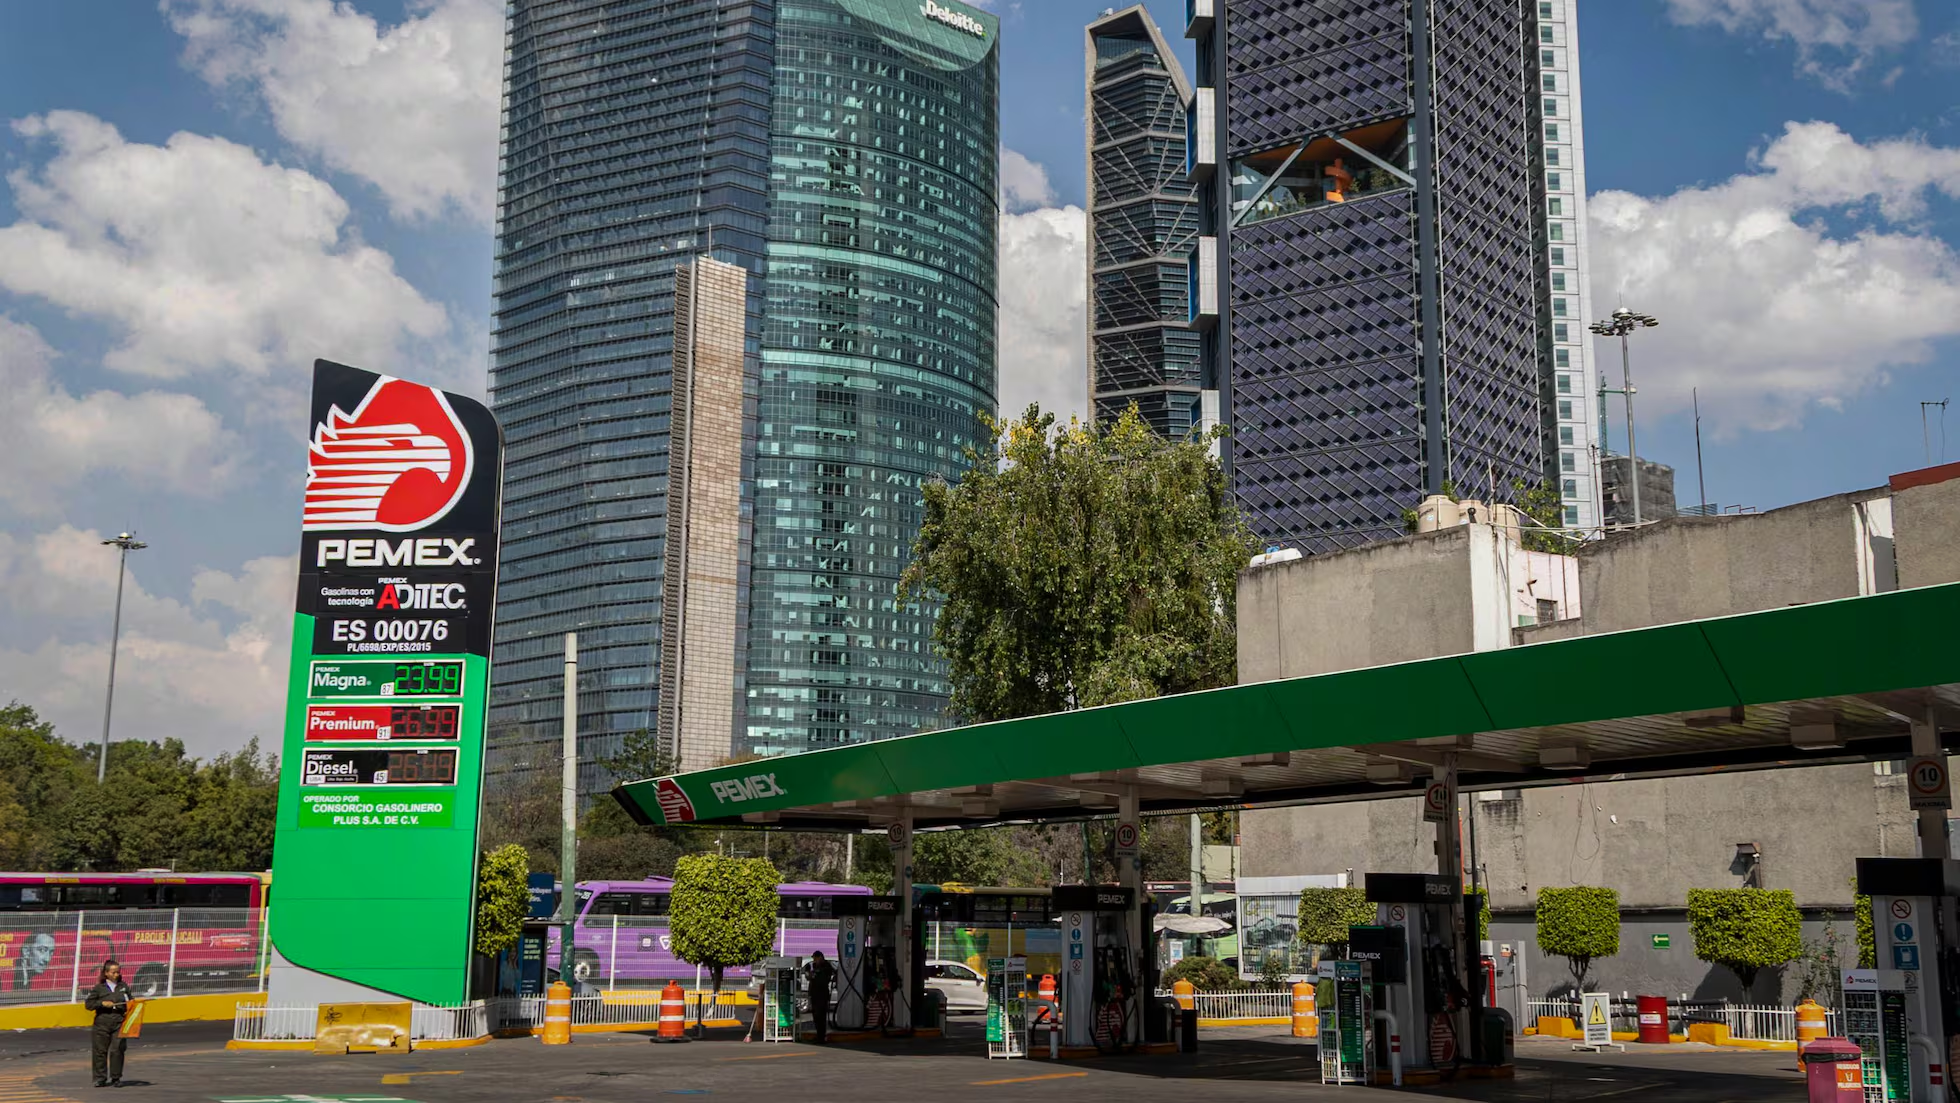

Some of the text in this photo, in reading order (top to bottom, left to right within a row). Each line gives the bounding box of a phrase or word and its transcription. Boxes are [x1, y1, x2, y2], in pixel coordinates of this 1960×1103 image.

[320, 587, 375, 596] Gasolinas con
[327, 597, 374, 608] tecnología
[332, 619, 449, 642] ES 00076
[394, 665, 460, 694] 23.99
[1919, 767, 1938, 782] 10
[303, 795, 360, 803] OPERADO POR
[312, 803, 443, 813] CONSORCIO GASOLINERO
[333, 815, 419, 825] PLUS S.A. DE C.V.
[1121, 829, 1132, 839] 10
[1425, 882, 1452, 895] PEMEX
[1097, 894, 1125, 904] PEMEX
[867, 901, 895, 911] PEMEX
[134, 931, 165, 944] PARQUE
[1352, 952, 1381, 960] PEMEX
